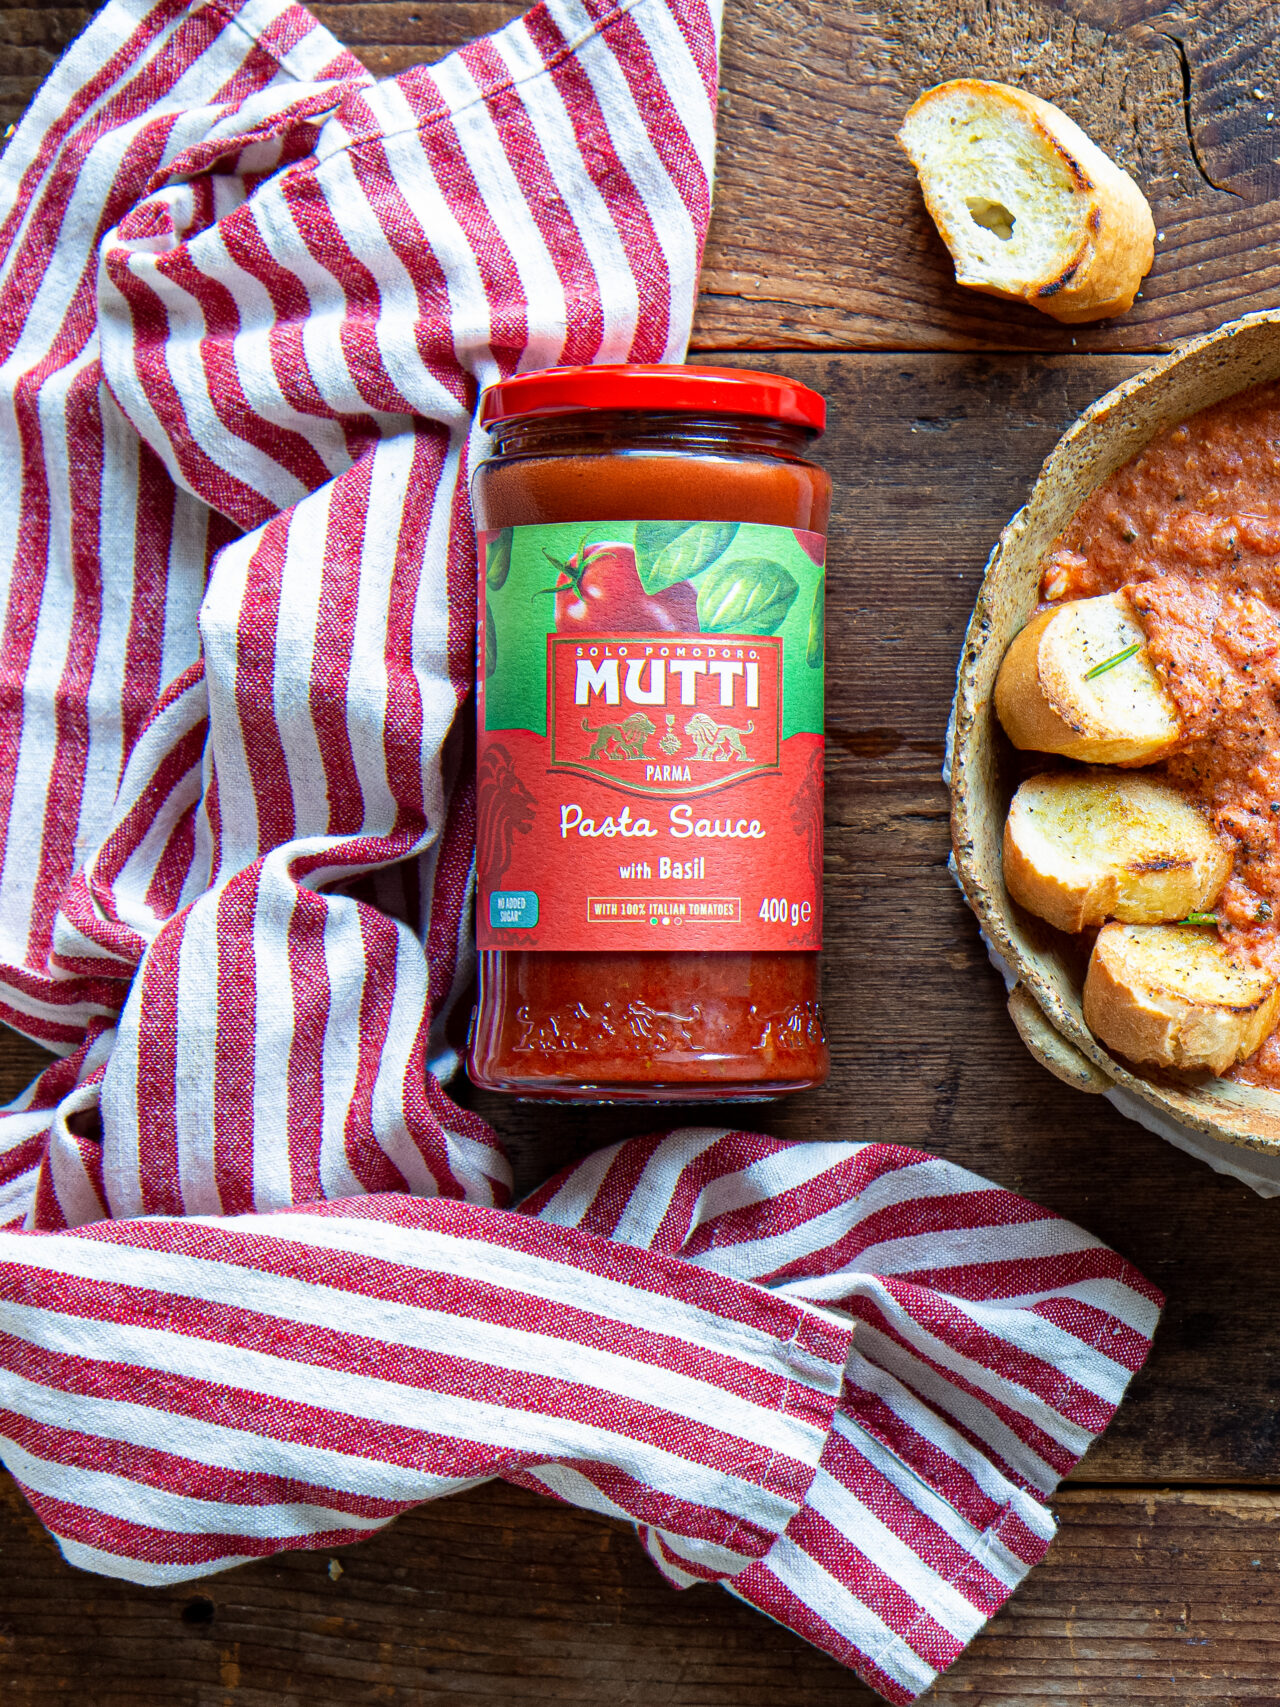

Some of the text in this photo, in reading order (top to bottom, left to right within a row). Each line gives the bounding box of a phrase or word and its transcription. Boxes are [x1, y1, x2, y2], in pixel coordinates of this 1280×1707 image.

[576, 647, 628, 657] SOLO
[575, 659, 760, 708] MUTTI
[645, 765, 692, 783] PARMA
[560, 804, 766, 839] Pasta Sauce
[619, 856, 705, 879] with Basil
[506, 897, 526, 909] ADDED
[594, 903, 734, 916] WITH 100% ITALIAN TOMATOES
[759, 897, 788, 922] 400
